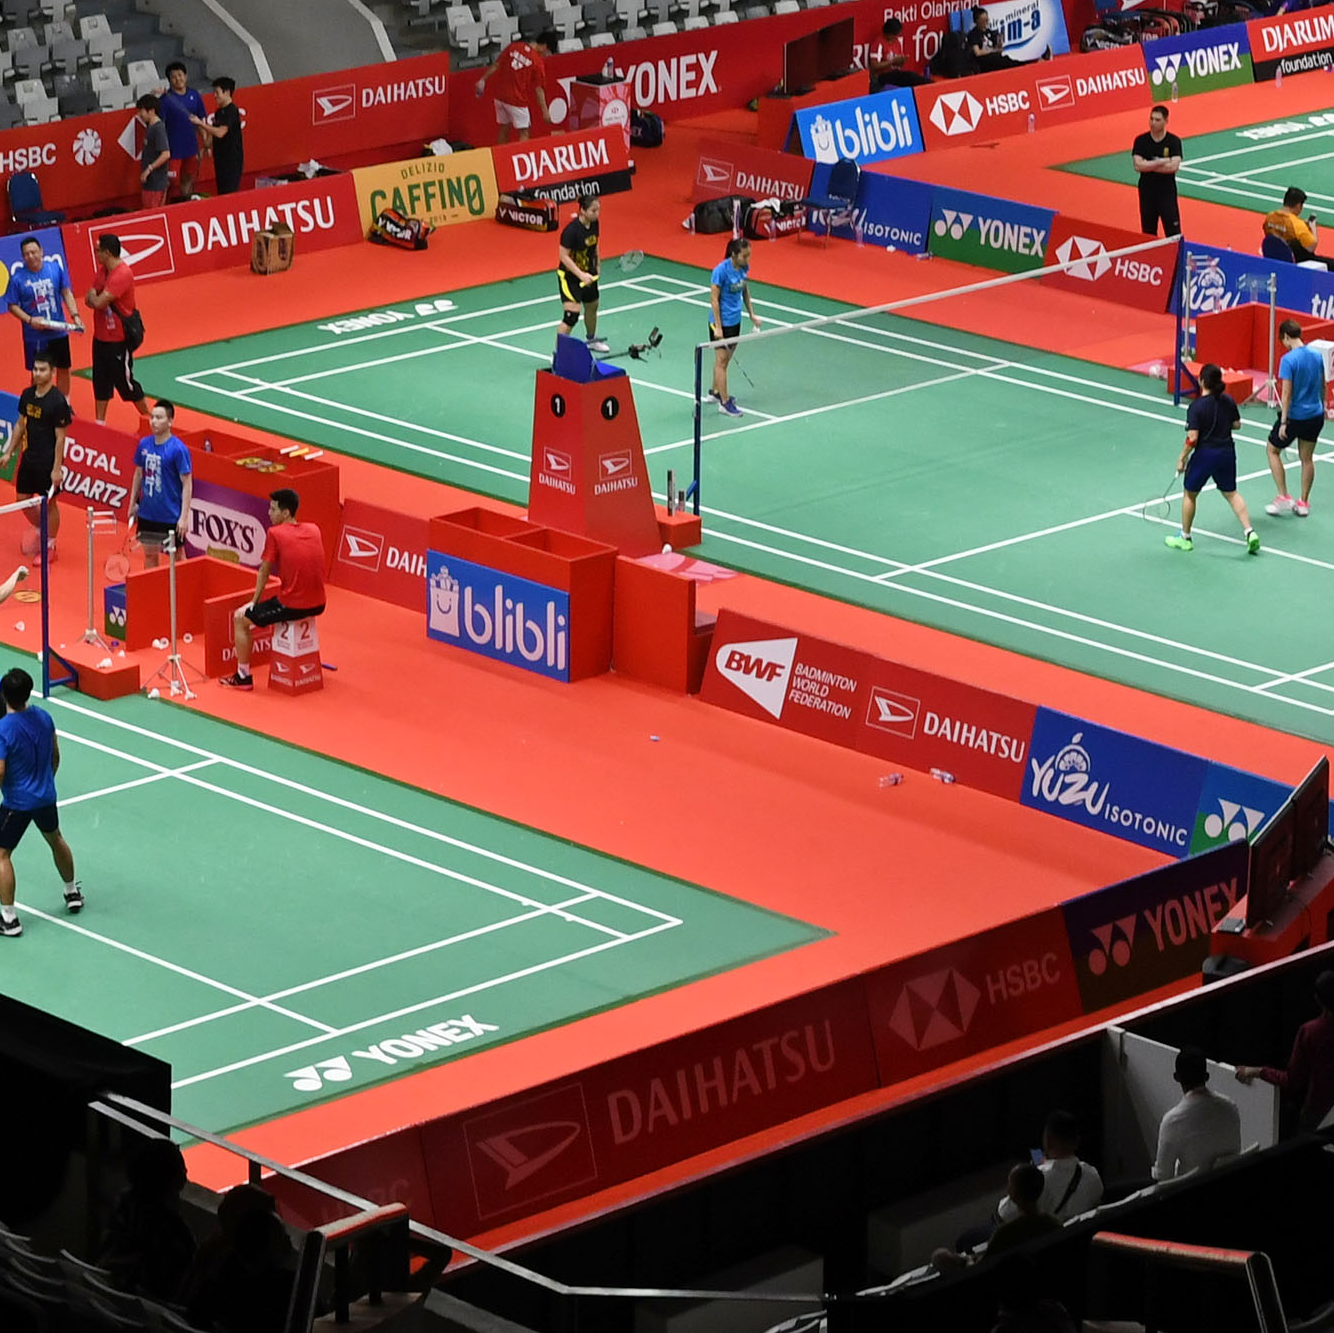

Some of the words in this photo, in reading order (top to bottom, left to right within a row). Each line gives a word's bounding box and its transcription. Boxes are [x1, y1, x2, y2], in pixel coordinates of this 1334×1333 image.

[1005, 0, 1040, 23] mineral
[1185, 42, 1242, 78] YONEX
[1280, 51, 1334, 75] foundation
[361, 75, 447, 108] DAIHATSU
[1076, 67, 1146, 97] DAIHATSU
[986, 90, 1030, 117] HSBC
[835, 98, 913, 160] blibli
[400, 161, 446, 181] DELIZIO
[511, 137, 610, 182] DJARUM
[533, 179, 601, 201] foundation
[736, 172, 805, 202] DAIHATSU
[181, 195, 335, 256] DAIHATSU
[509, 211, 544, 226] VICTOR
[863, 222, 922, 246] ISOTONIC
[977, 217, 1047, 258] YONEX
[1114, 258, 1164, 286] HSBC
[554, 397, 561, 414] 1
[605, 399, 613, 416] 1
[63, 436, 121, 476] TOTAL
[538, 472, 576, 495] DAIHATSU
[594, 476, 638, 496] DAIHATSU
[190, 506, 256, 554] FOX'S
[300, 622, 311, 641] 2
[464, 583, 567, 671] blibli
[723, 649, 786, 684] BWF
[795, 662, 858, 694] BADMINTON
[792, 676, 830, 699] WORLD
[788, 688, 852, 721] FEDERATION
[923, 711, 1026, 764] DAIHATSU
[1030, 755, 1109, 817] YUZU
[1104, 802, 1188, 847] ISOTONIC
[986, 951, 1062, 1006] HSBC
[351, 1013, 500, 1066] YONEX
[607, 1018, 836, 1146] DAIHATSU
